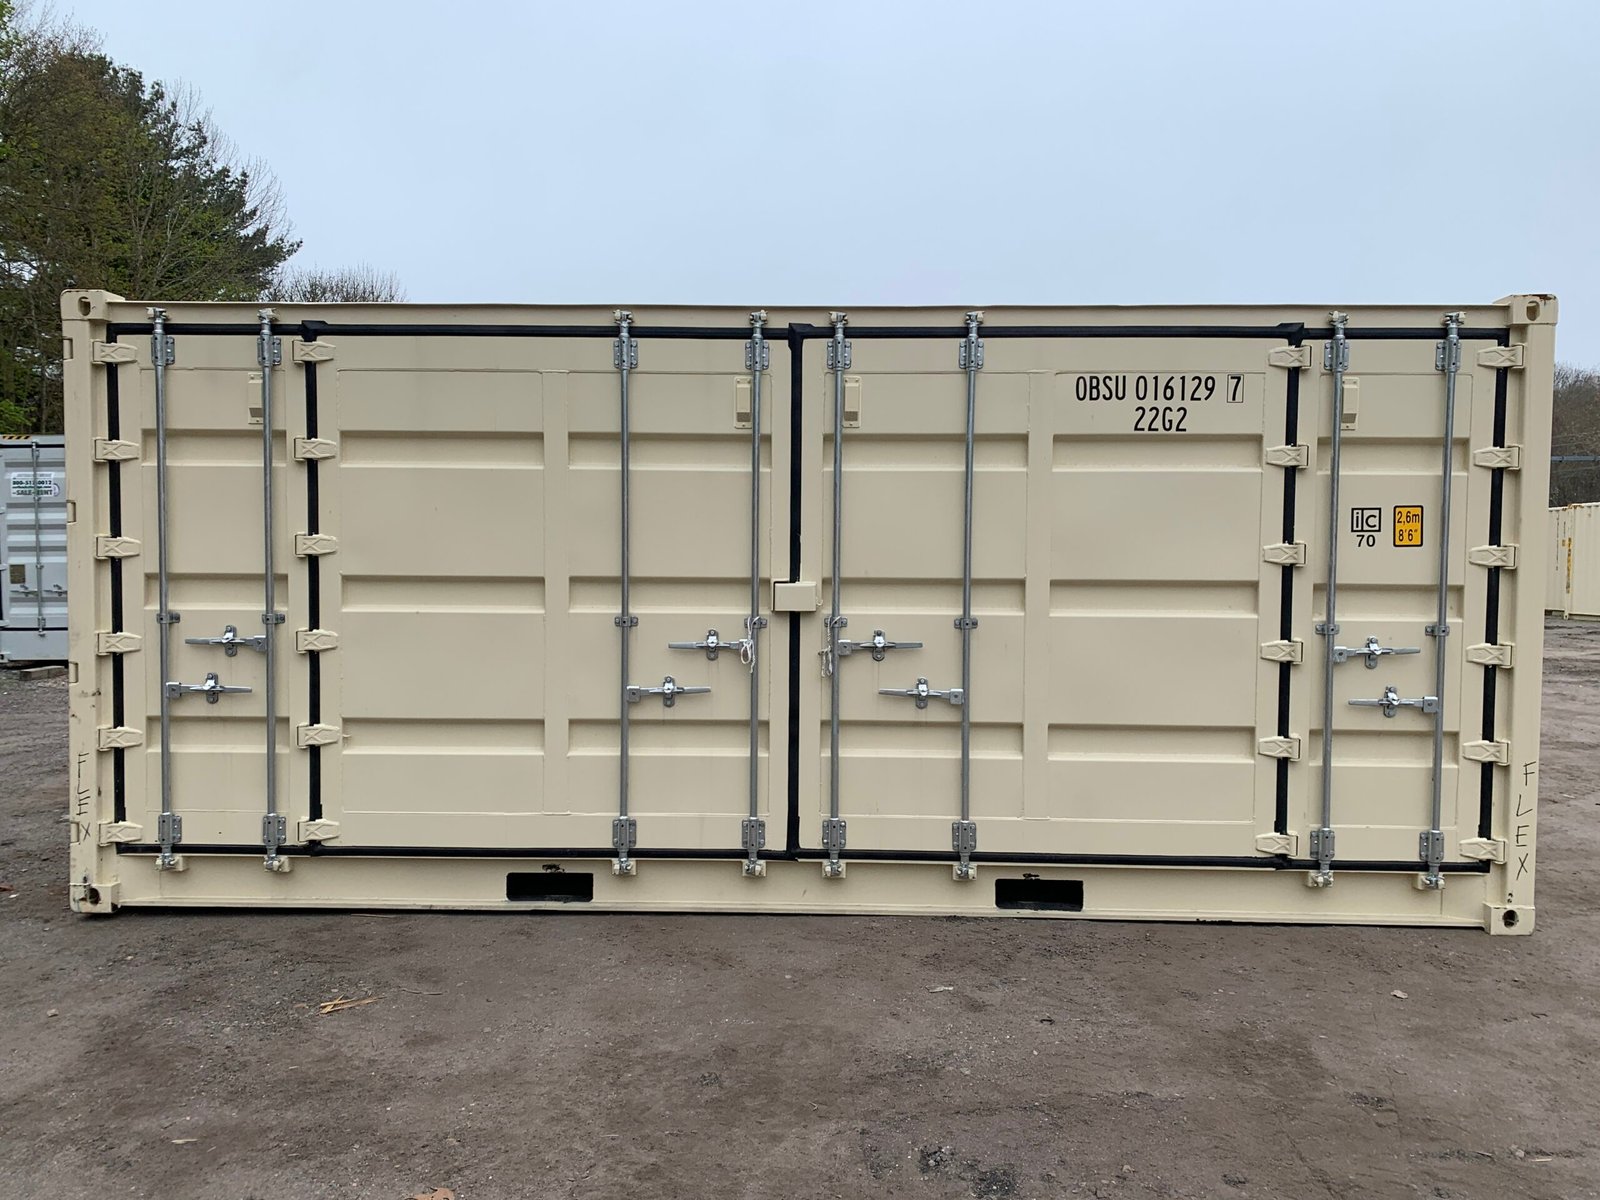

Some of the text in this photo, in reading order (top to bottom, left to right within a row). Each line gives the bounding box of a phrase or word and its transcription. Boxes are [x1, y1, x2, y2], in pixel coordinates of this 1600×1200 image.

[1135, 375, 1216, 401] 016129
[1229, 375, 1242, 402] 7
[1133, 406, 1188, 432] 22G2
[1397, 510, 1420, 525] 2,6m
[1356, 534, 1376, 548] 70
[1515, 760, 1537, 881] FLEX
